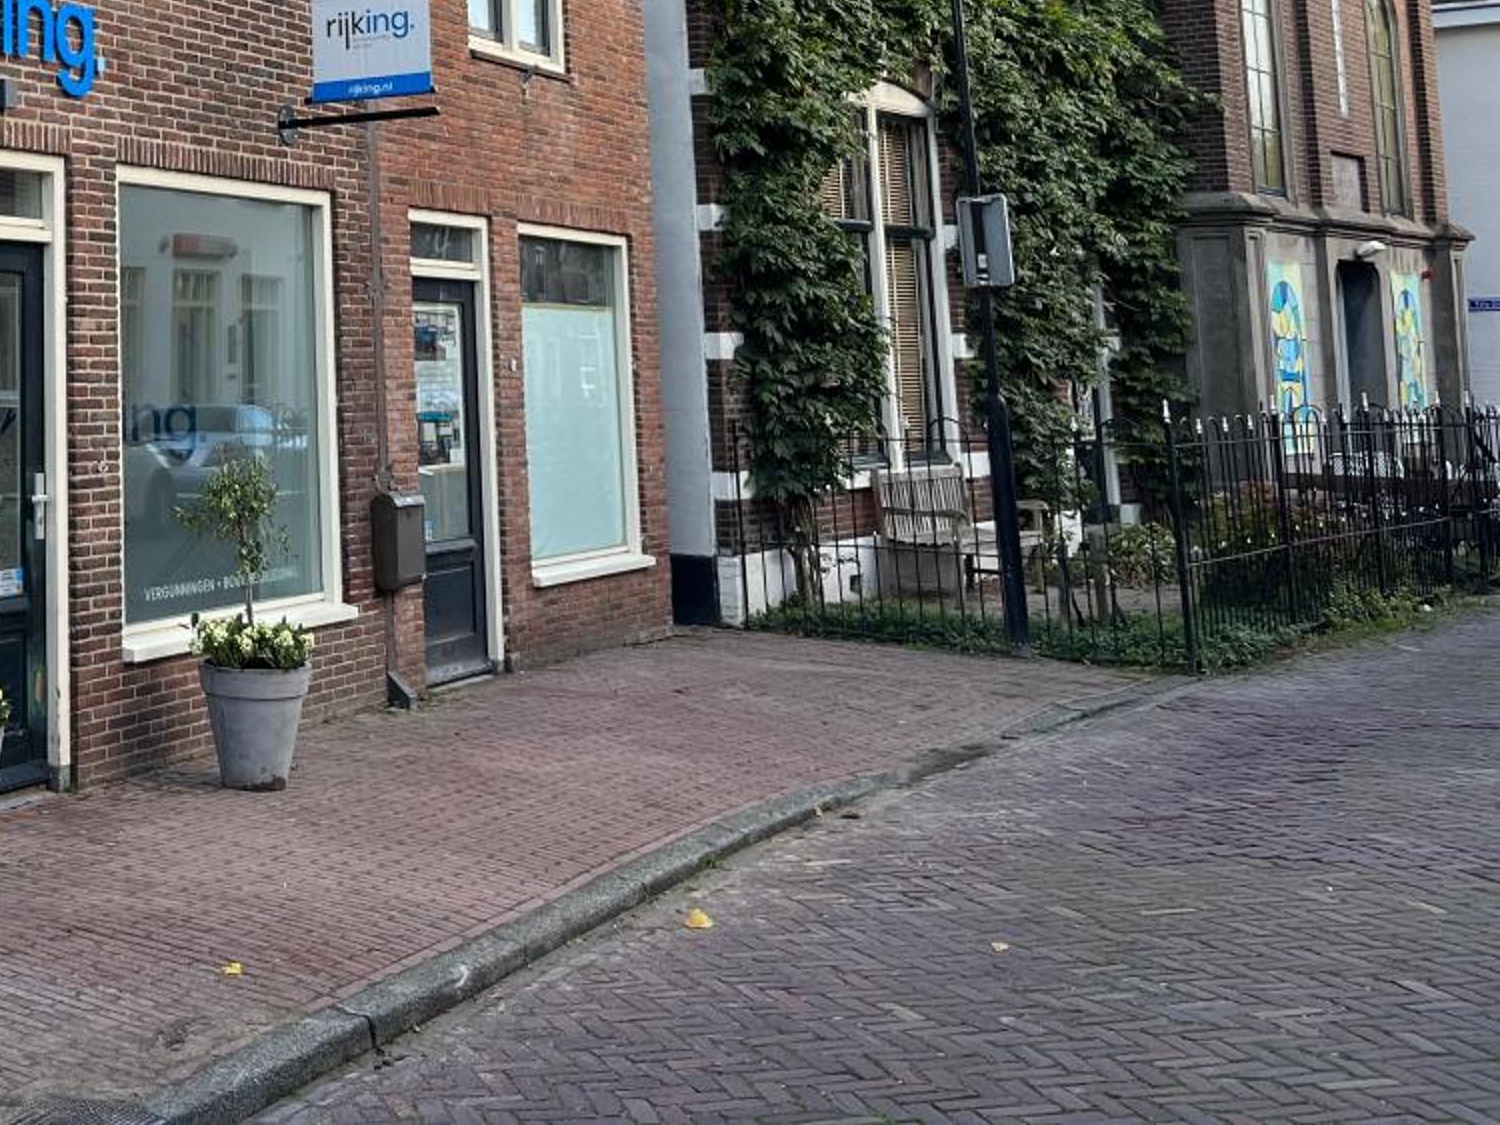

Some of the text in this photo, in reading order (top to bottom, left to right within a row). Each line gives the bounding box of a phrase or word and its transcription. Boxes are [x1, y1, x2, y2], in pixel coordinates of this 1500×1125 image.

[326, 9, 415, 51] rijking.
[347, 81, 393, 97] rijking.nl
[144, 578, 216, 602] VERGUNNINGEN
